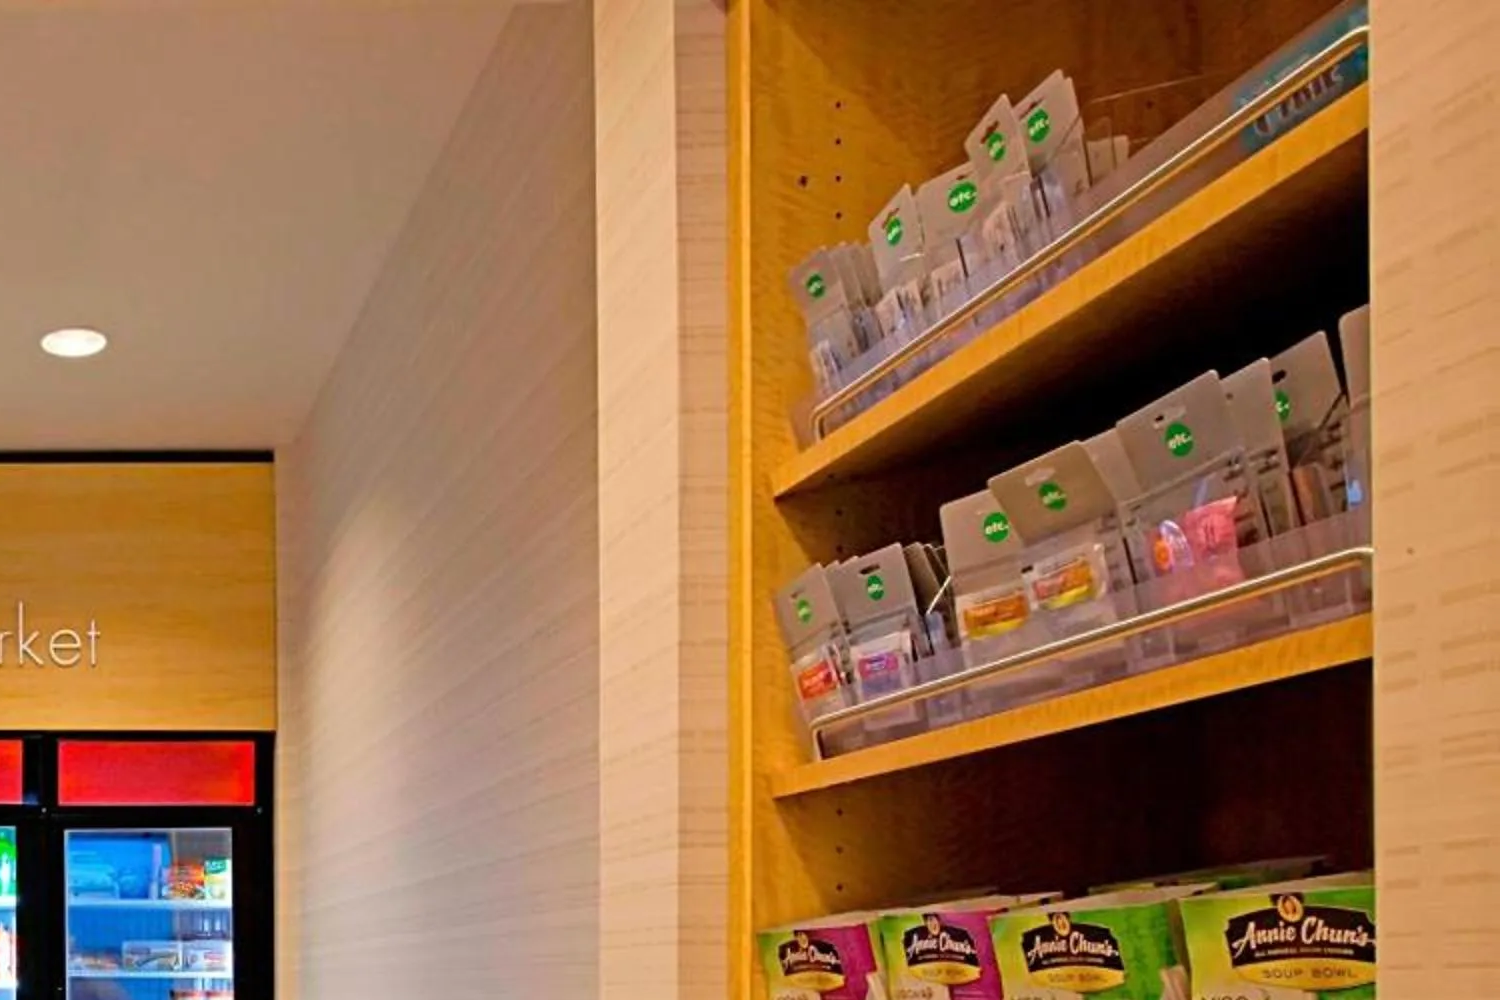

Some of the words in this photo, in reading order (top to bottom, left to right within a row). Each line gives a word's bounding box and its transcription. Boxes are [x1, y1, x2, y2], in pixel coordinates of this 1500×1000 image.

[1167, 433, 1193, 450] etc.
[984, 520, 1010, 535] etc.
[1231, 920, 1297, 959] Annie
[1301, 916, 1375, 948] Chun's
[1261, 966, 1304, 980] SOUP
[1311, 966, 1358, 979] BOWL
